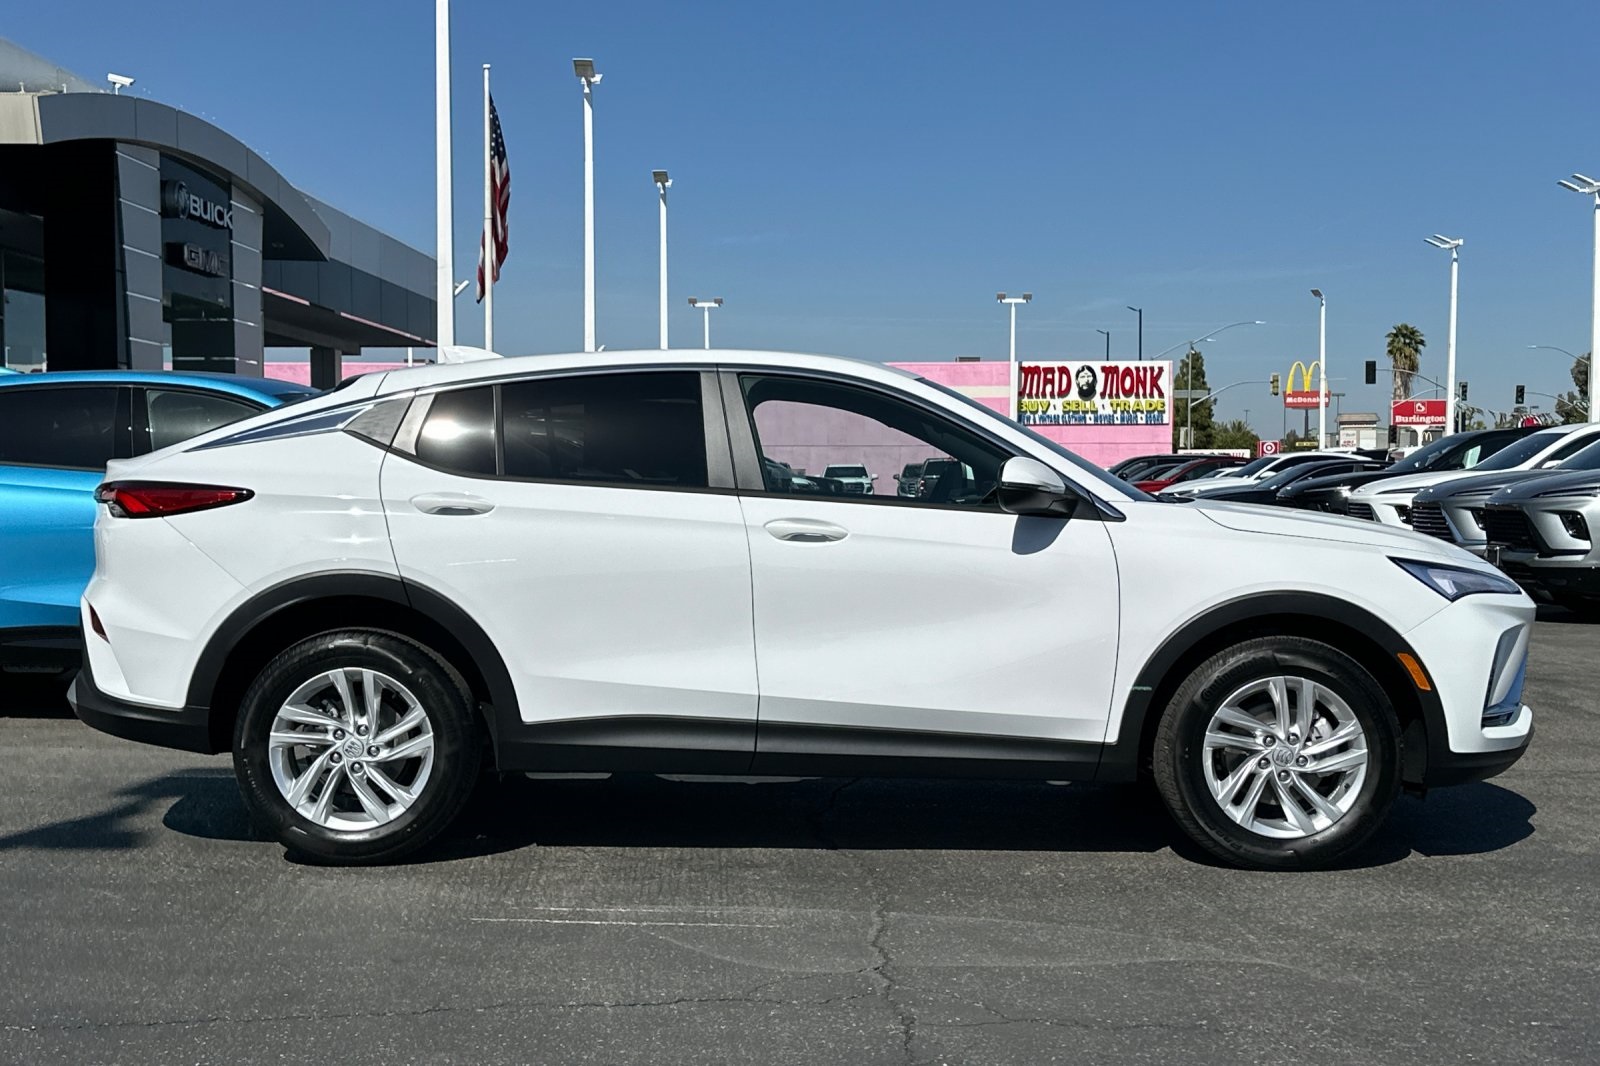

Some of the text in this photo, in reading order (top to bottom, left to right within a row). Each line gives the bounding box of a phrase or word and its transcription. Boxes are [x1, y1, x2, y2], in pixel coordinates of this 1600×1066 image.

[189, 194, 233, 229] BUICK
[184, 242, 228, 277] GMC
[1018, 365, 1165, 399] MAD MONK
[1019, 400, 1166, 414] BUY SELL TRADE
[1395, 415, 1446, 424] Burlington
